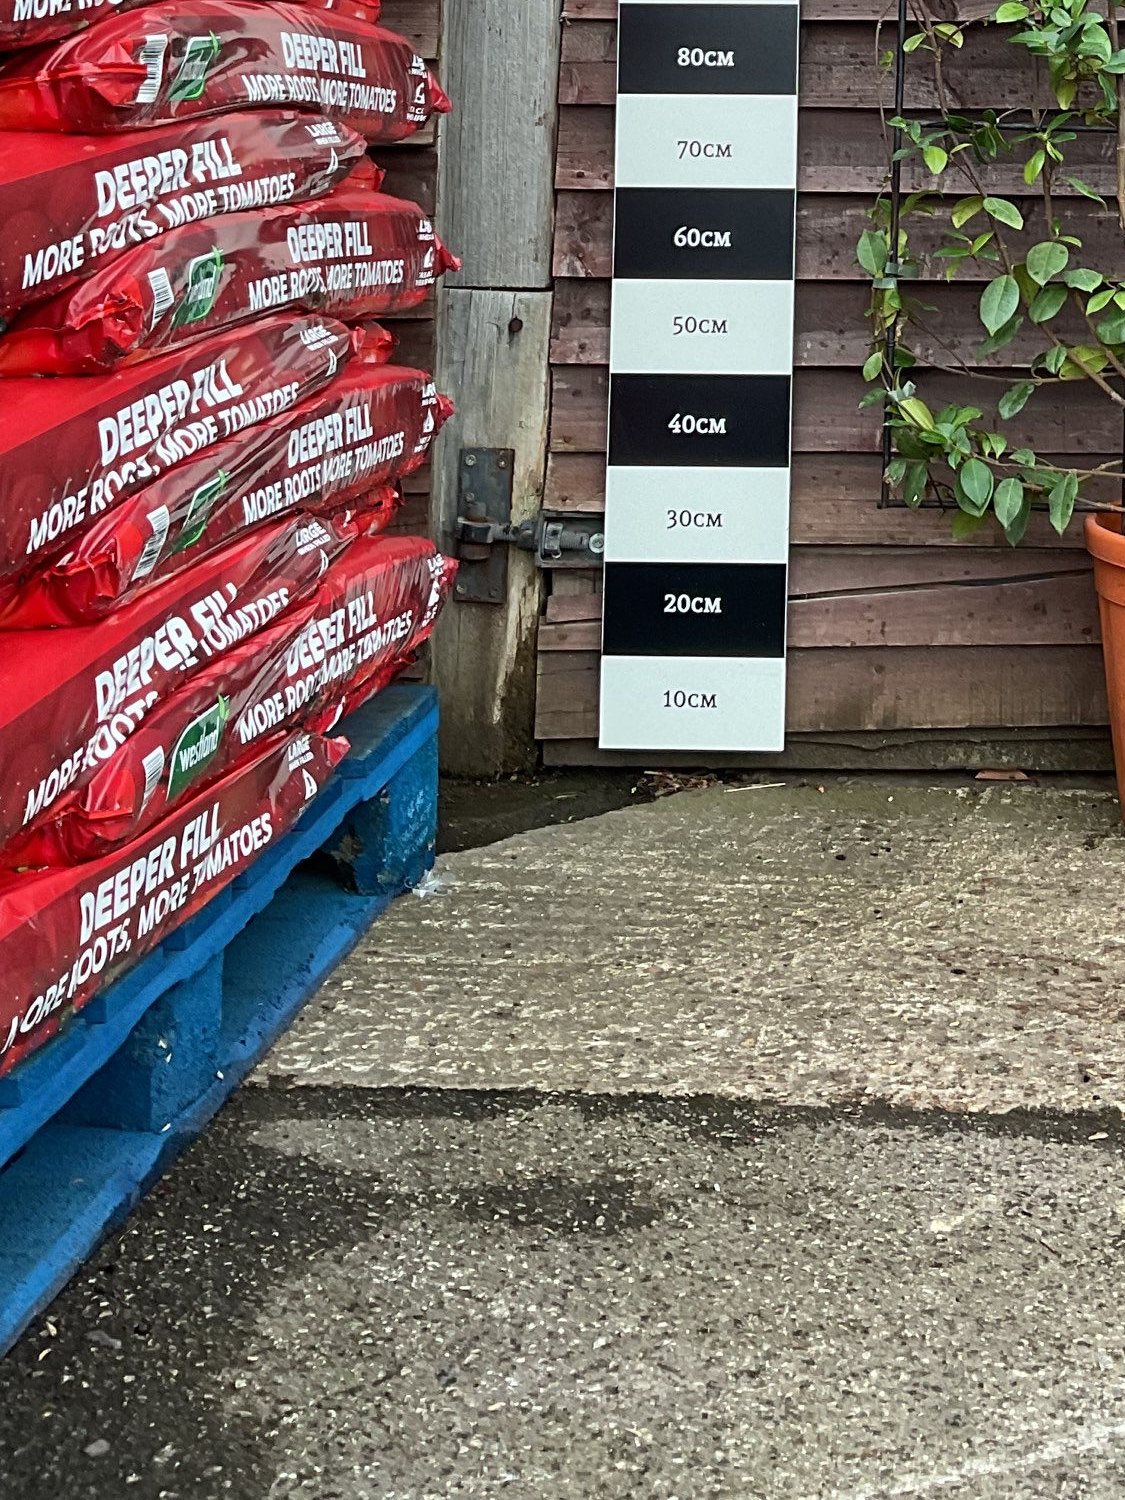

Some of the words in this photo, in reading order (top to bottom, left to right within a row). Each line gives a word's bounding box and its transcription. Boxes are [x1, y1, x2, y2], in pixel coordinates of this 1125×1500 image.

[280, 32, 340, 74] DEEPER
[338, 40, 366, 78] FILL
[241, 74, 286, 102] MORE
[320, 78, 348, 107] MORE
[349, 82, 397, 114] TOMATOES
[95, 148, 190, 217] DEEPER
[191, 138, 243, 183] FILL
[21, 233, 85, 289] MORE
[157, 190, 219, 228] MORE
[222, 173, 295, 215] TOMATOES
[287, 222, 342, 263] DEEPER
[344, 222, 372, 257] FILL
[248, 275, 288, 311] MORE
[354, 260, 404, 288] TOMATOES
[26, 488, 87, 553] MORE
[156, 414, 219, 466] MORE
[218, 382, 300, 436] TOMATOES
[288, 412, 343, 469] DEEPER
[344, 403, 373, 445] FILL
[242, 480, 282, 526] MORE
[354, 431, 405, 473] TOMATOES
[347, 590, 378, 639] FILL
[95, 615, 199, 723] DEEPER
[239, 692, 285, 744] MORE
[22, 747, 84, 825] MORE
[80, 836, 176, 946] DEEPER
[180, 802, 221, 869] FILL
[137, 875, 190, 939] MORE
